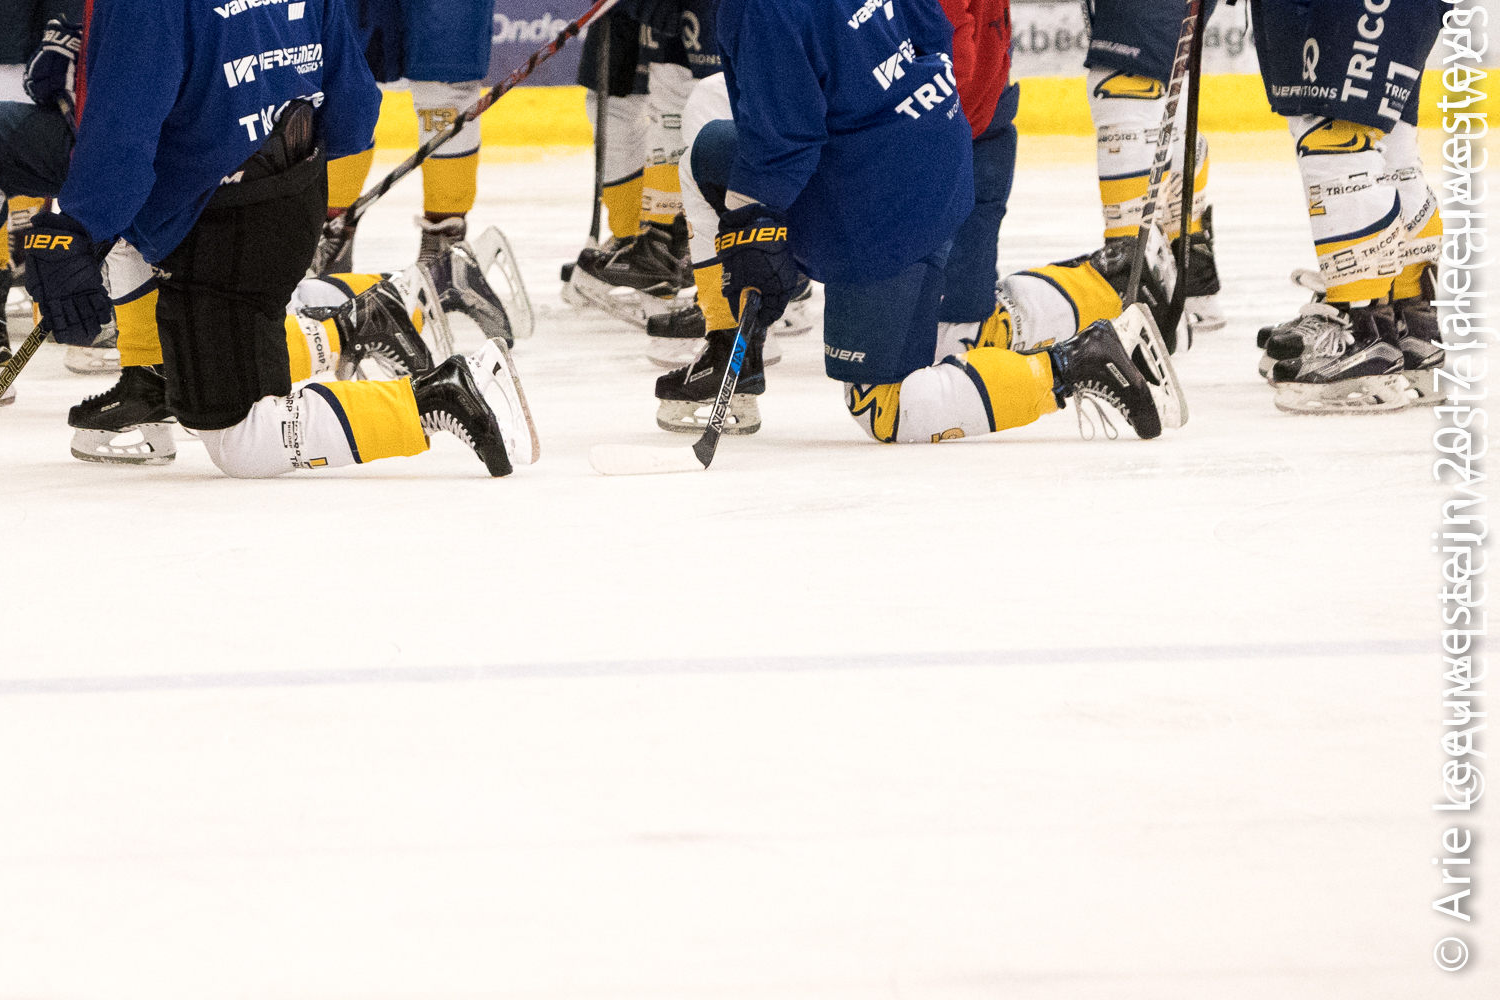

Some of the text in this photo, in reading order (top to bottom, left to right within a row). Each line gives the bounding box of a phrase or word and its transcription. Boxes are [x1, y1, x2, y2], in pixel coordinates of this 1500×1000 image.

[24, 234, 74, 250] UER
[714, 226, 788, 254] BAUER
[824, 344, 867, 363] AUER
